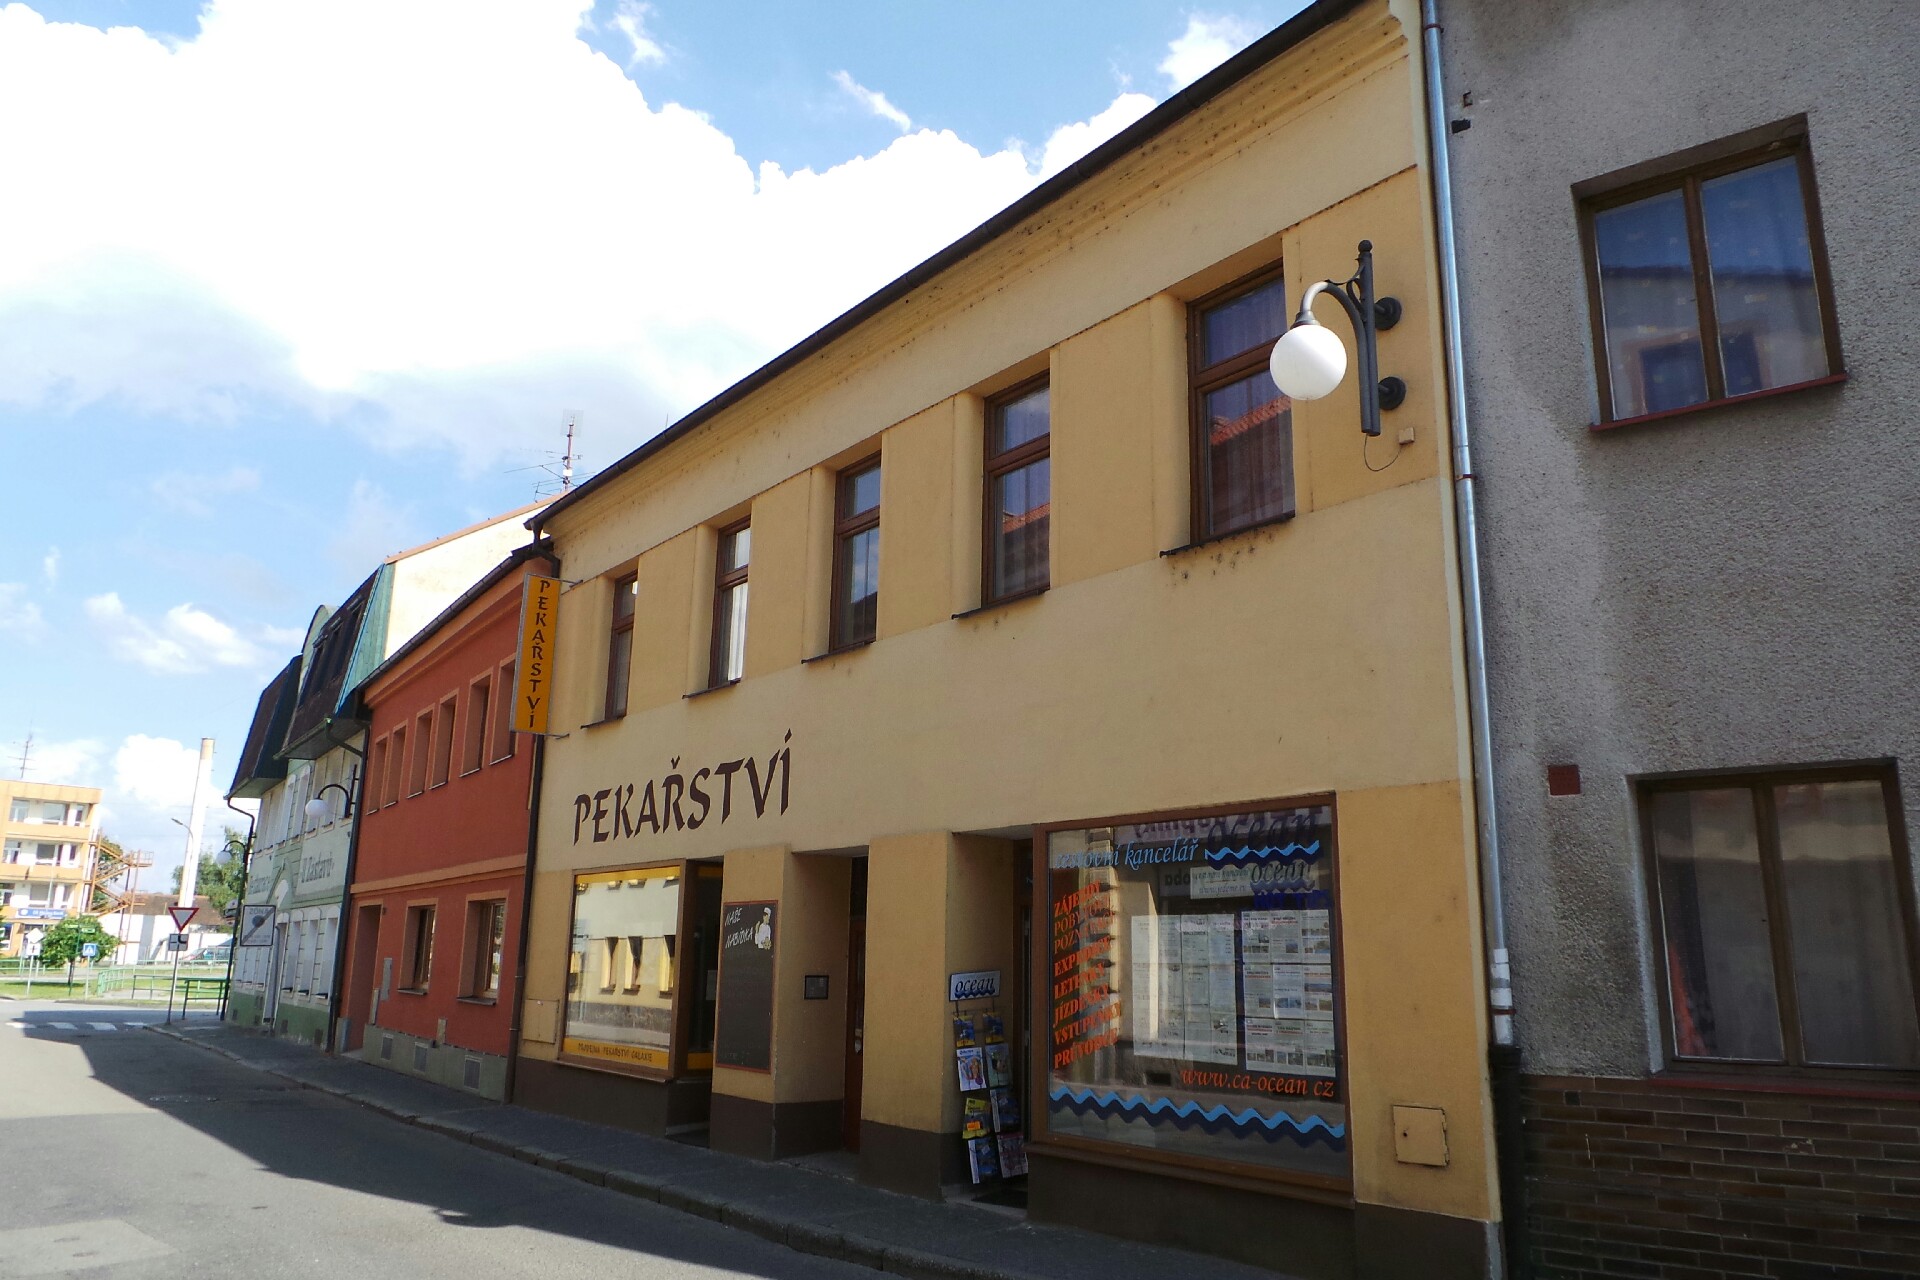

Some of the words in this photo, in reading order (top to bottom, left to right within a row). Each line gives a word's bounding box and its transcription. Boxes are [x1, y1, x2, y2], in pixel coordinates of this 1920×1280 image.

[526, 579, 551, 728] PEKAŘSTVÍ
[573, 728, 793, 846] PEKAŘSTVÍ
[1125, 837, 1199, 870] kancelář
[725, 907, 743, 927] NAŠE
[725, 927, 754, 950] NABÍDKA
[955, 976, 995, 993] ocean
